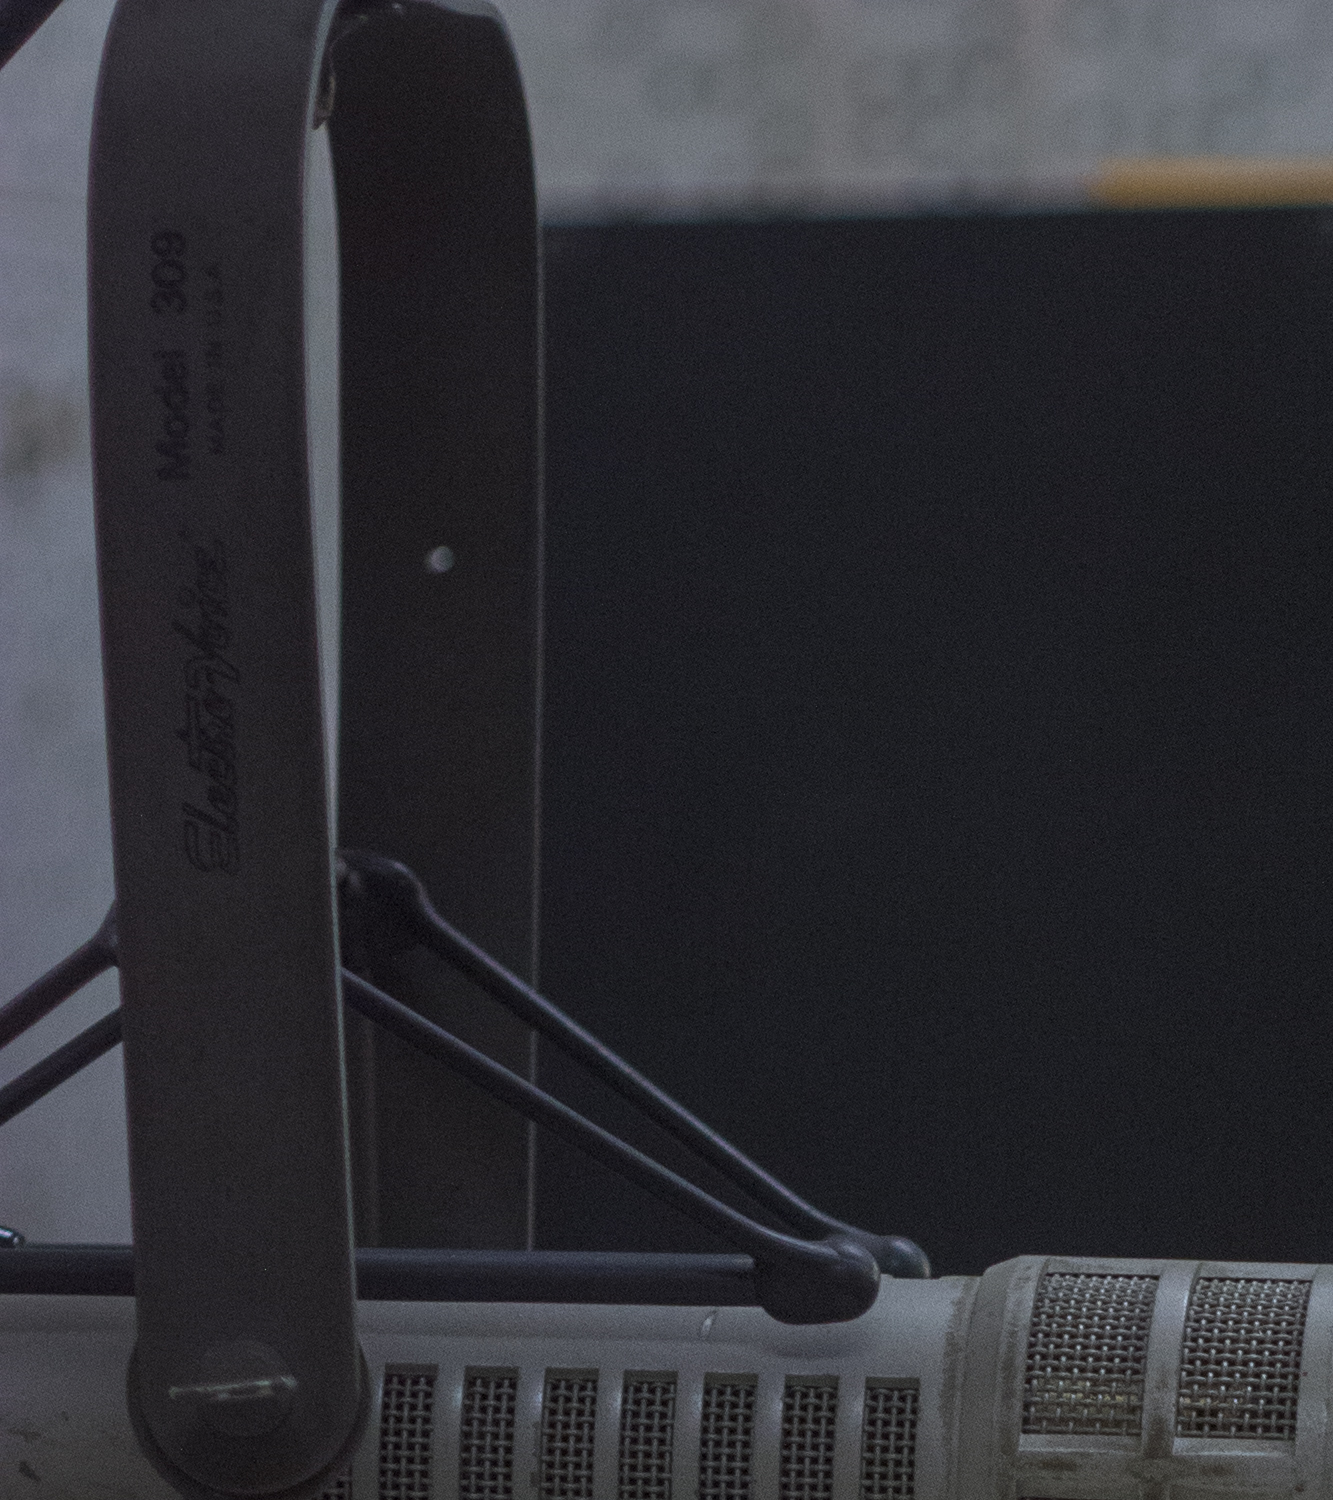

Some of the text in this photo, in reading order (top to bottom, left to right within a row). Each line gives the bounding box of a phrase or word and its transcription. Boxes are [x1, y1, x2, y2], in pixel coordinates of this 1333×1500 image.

[149, 232, 191, 481] Model 309
[204, 341, 224, 369] IN
